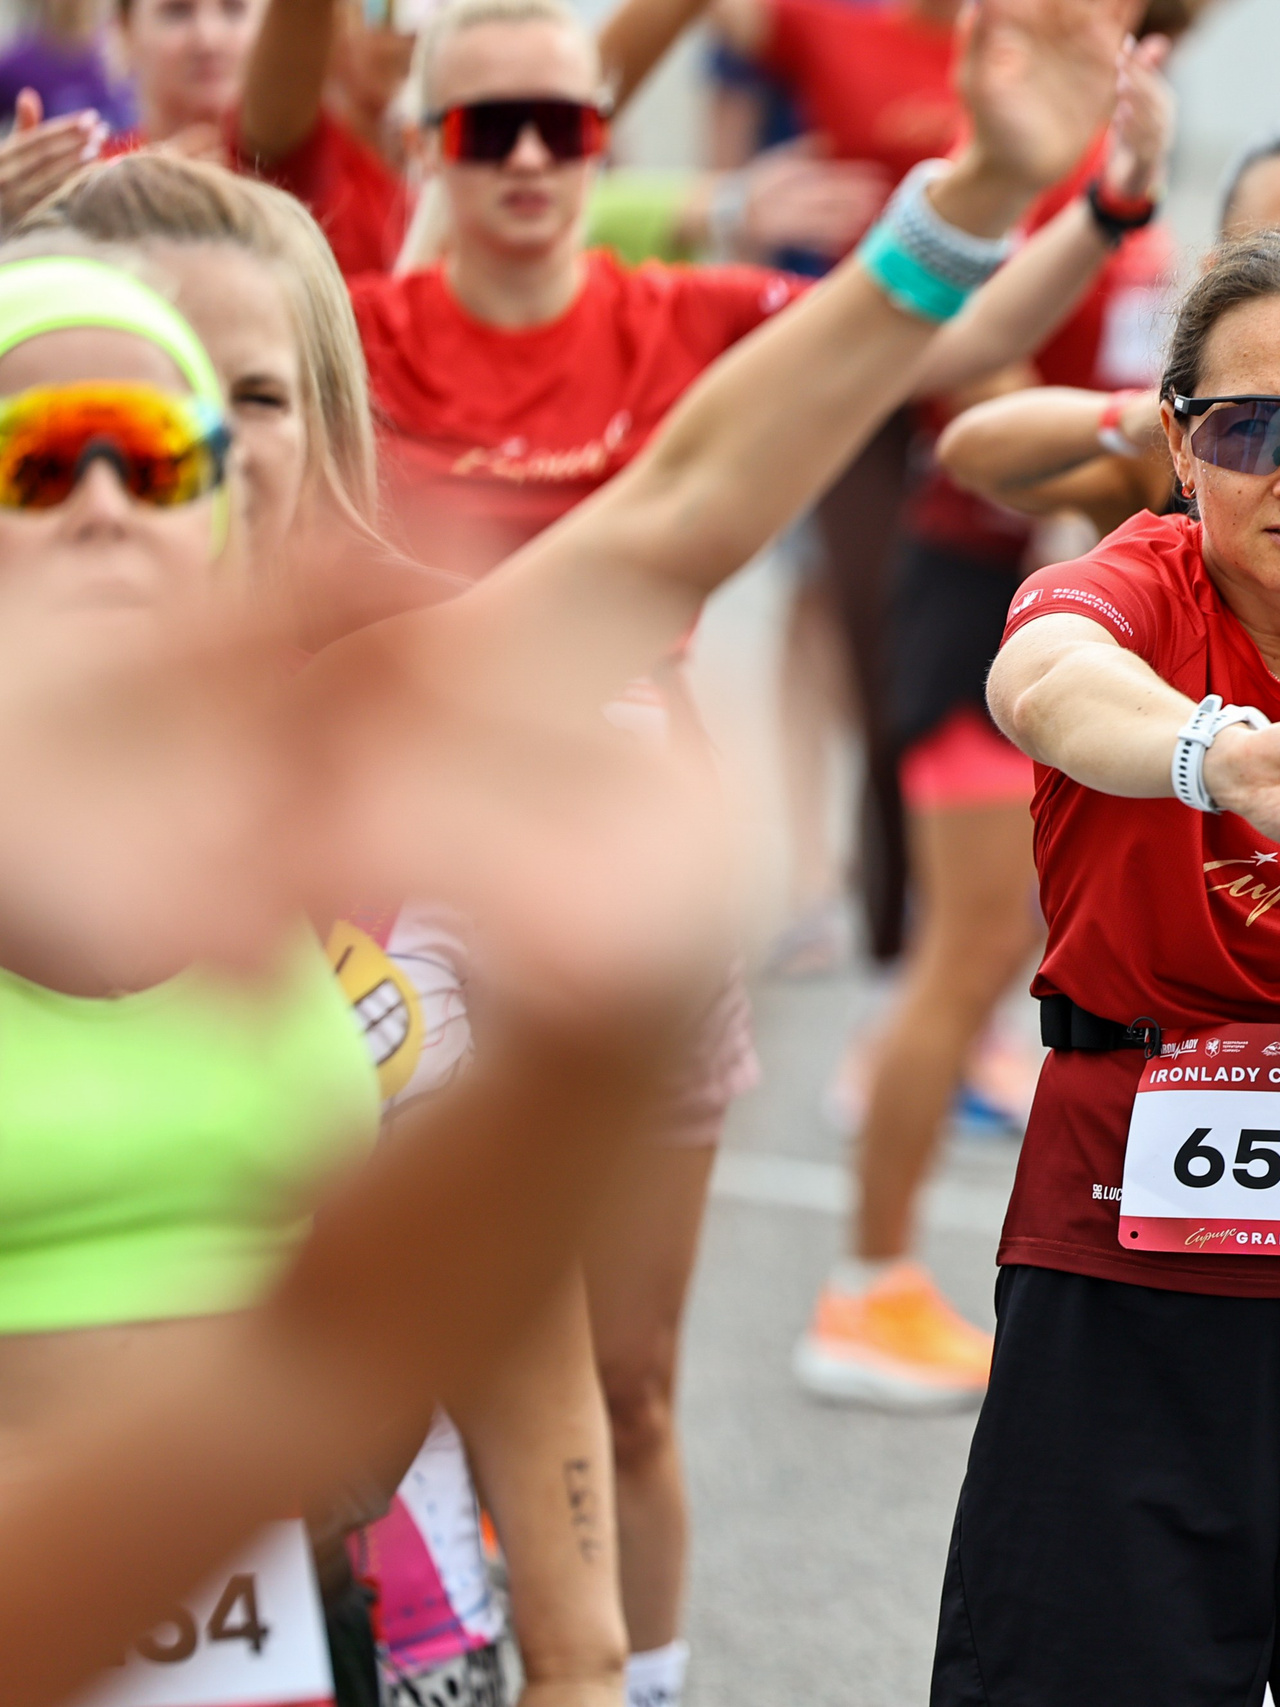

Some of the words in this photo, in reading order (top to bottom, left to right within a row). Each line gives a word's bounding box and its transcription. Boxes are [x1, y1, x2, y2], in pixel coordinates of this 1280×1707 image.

[1051, 593, 1126, 633] ТЕРРИТОРИЯ
[1052, 587, 1134, 637] ФЕДЕРАЛЬНАЯ
[1181, 1038, 1199, 1050] LADY
[1149, 1066, 1261, 1084] IRONLADY
